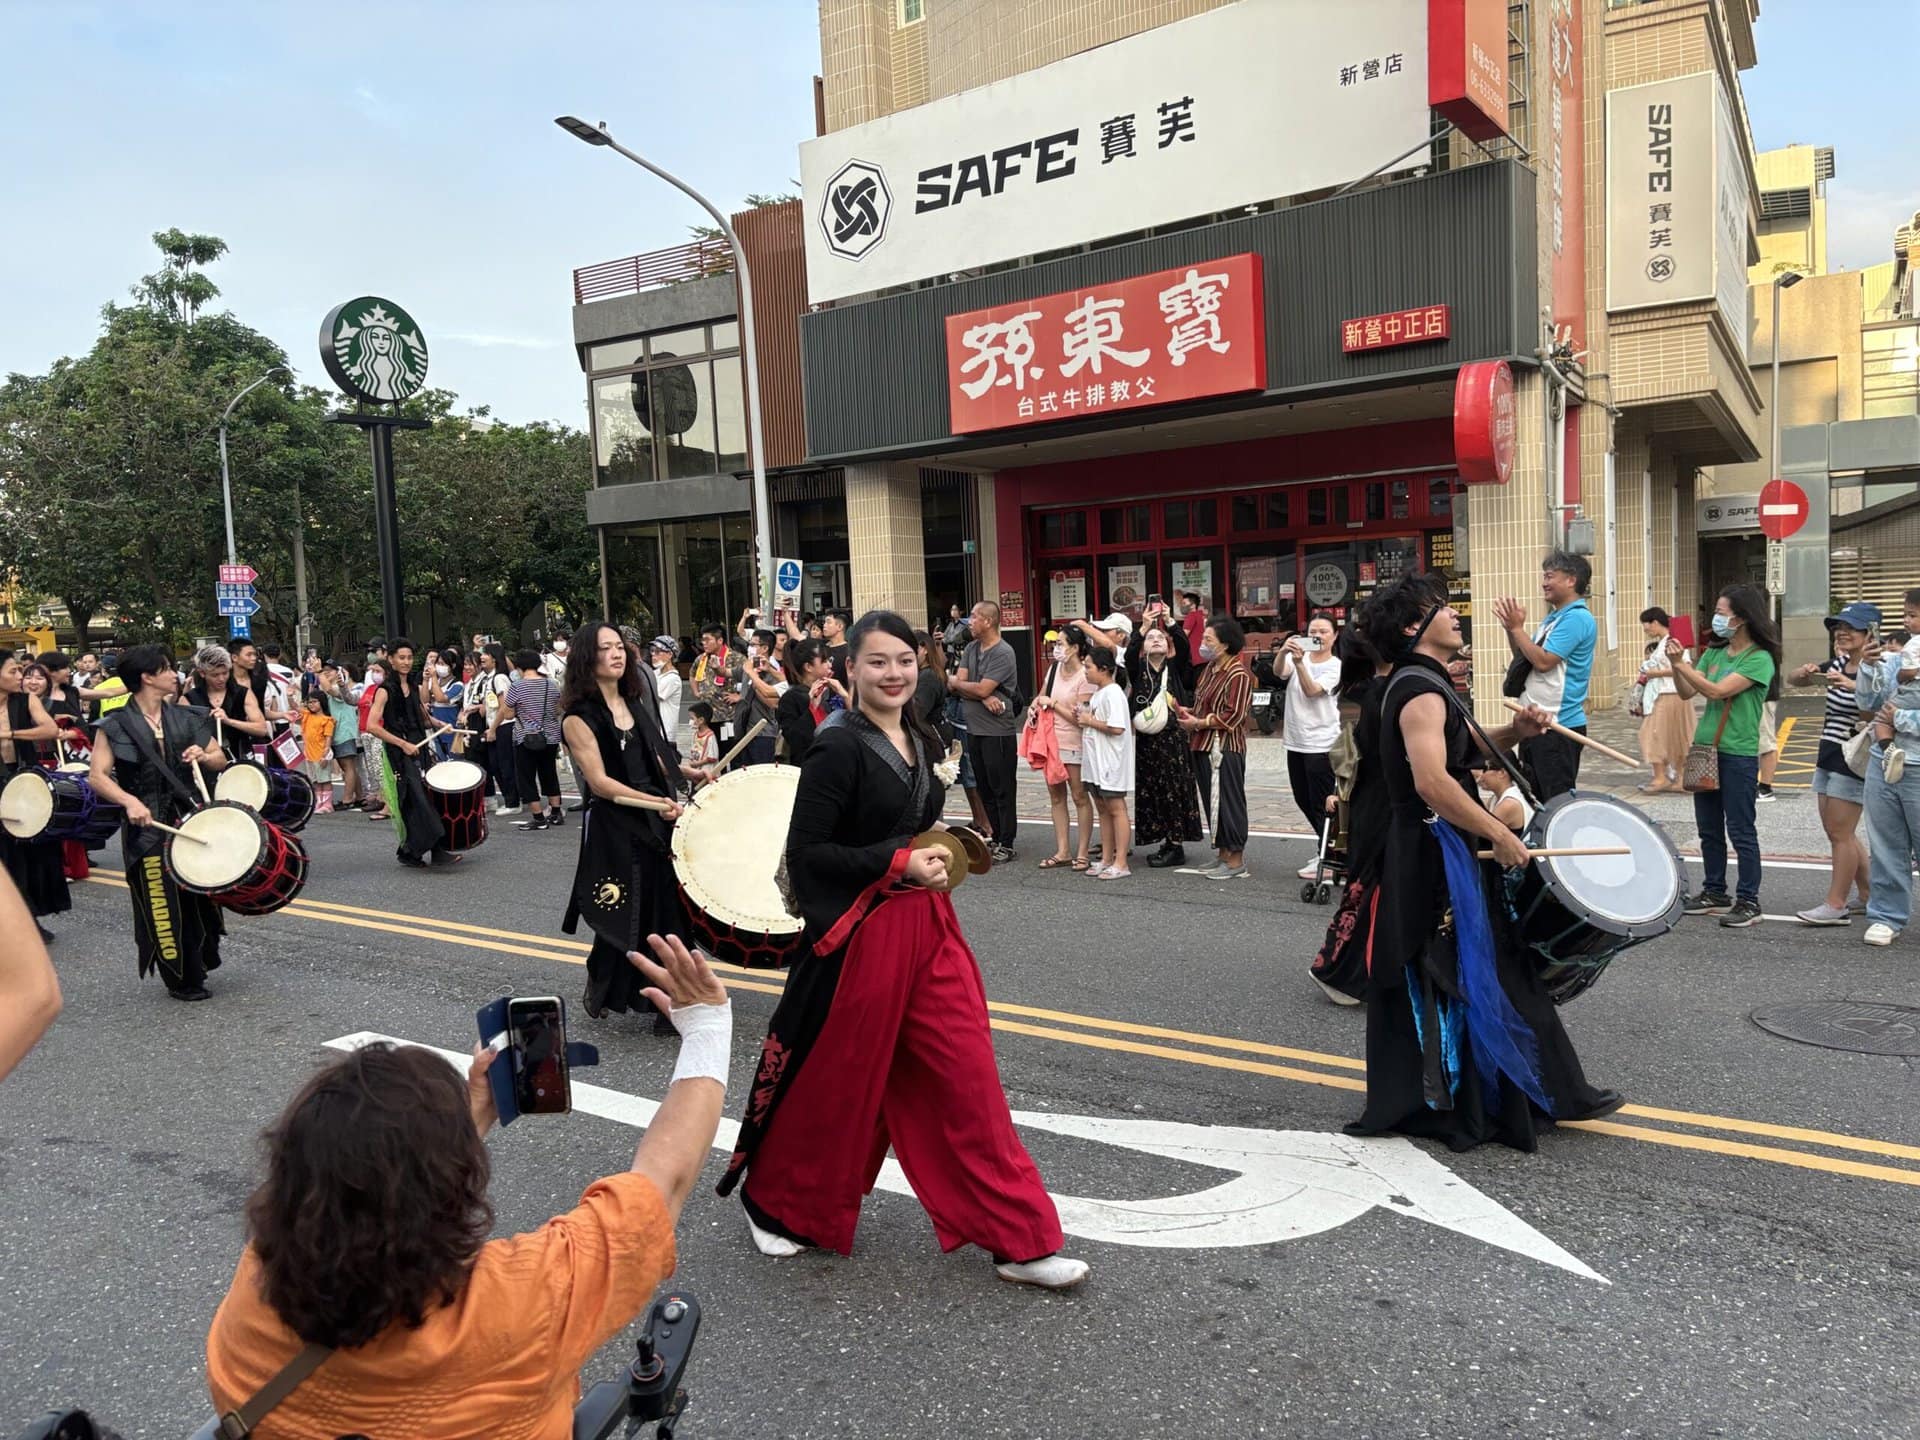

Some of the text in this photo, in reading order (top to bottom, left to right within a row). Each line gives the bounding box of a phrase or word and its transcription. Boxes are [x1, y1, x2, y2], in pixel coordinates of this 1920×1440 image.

[1339, 53, 1403, 87] 新營店
[915, 96, 1196, 214] SAFE 賽芙
[1648, 104, 1672, 249] SAFE 賽芙
[959, 268, 1232, 400] 孫東寶
[1345, 309, 1443, 348] 新營中正店
[1017, 376, 1156, 418] 台式牛排教父
[1312, 573, 1341, 582] 100%
[143, 855, 178, 960] NOWADAIKO
